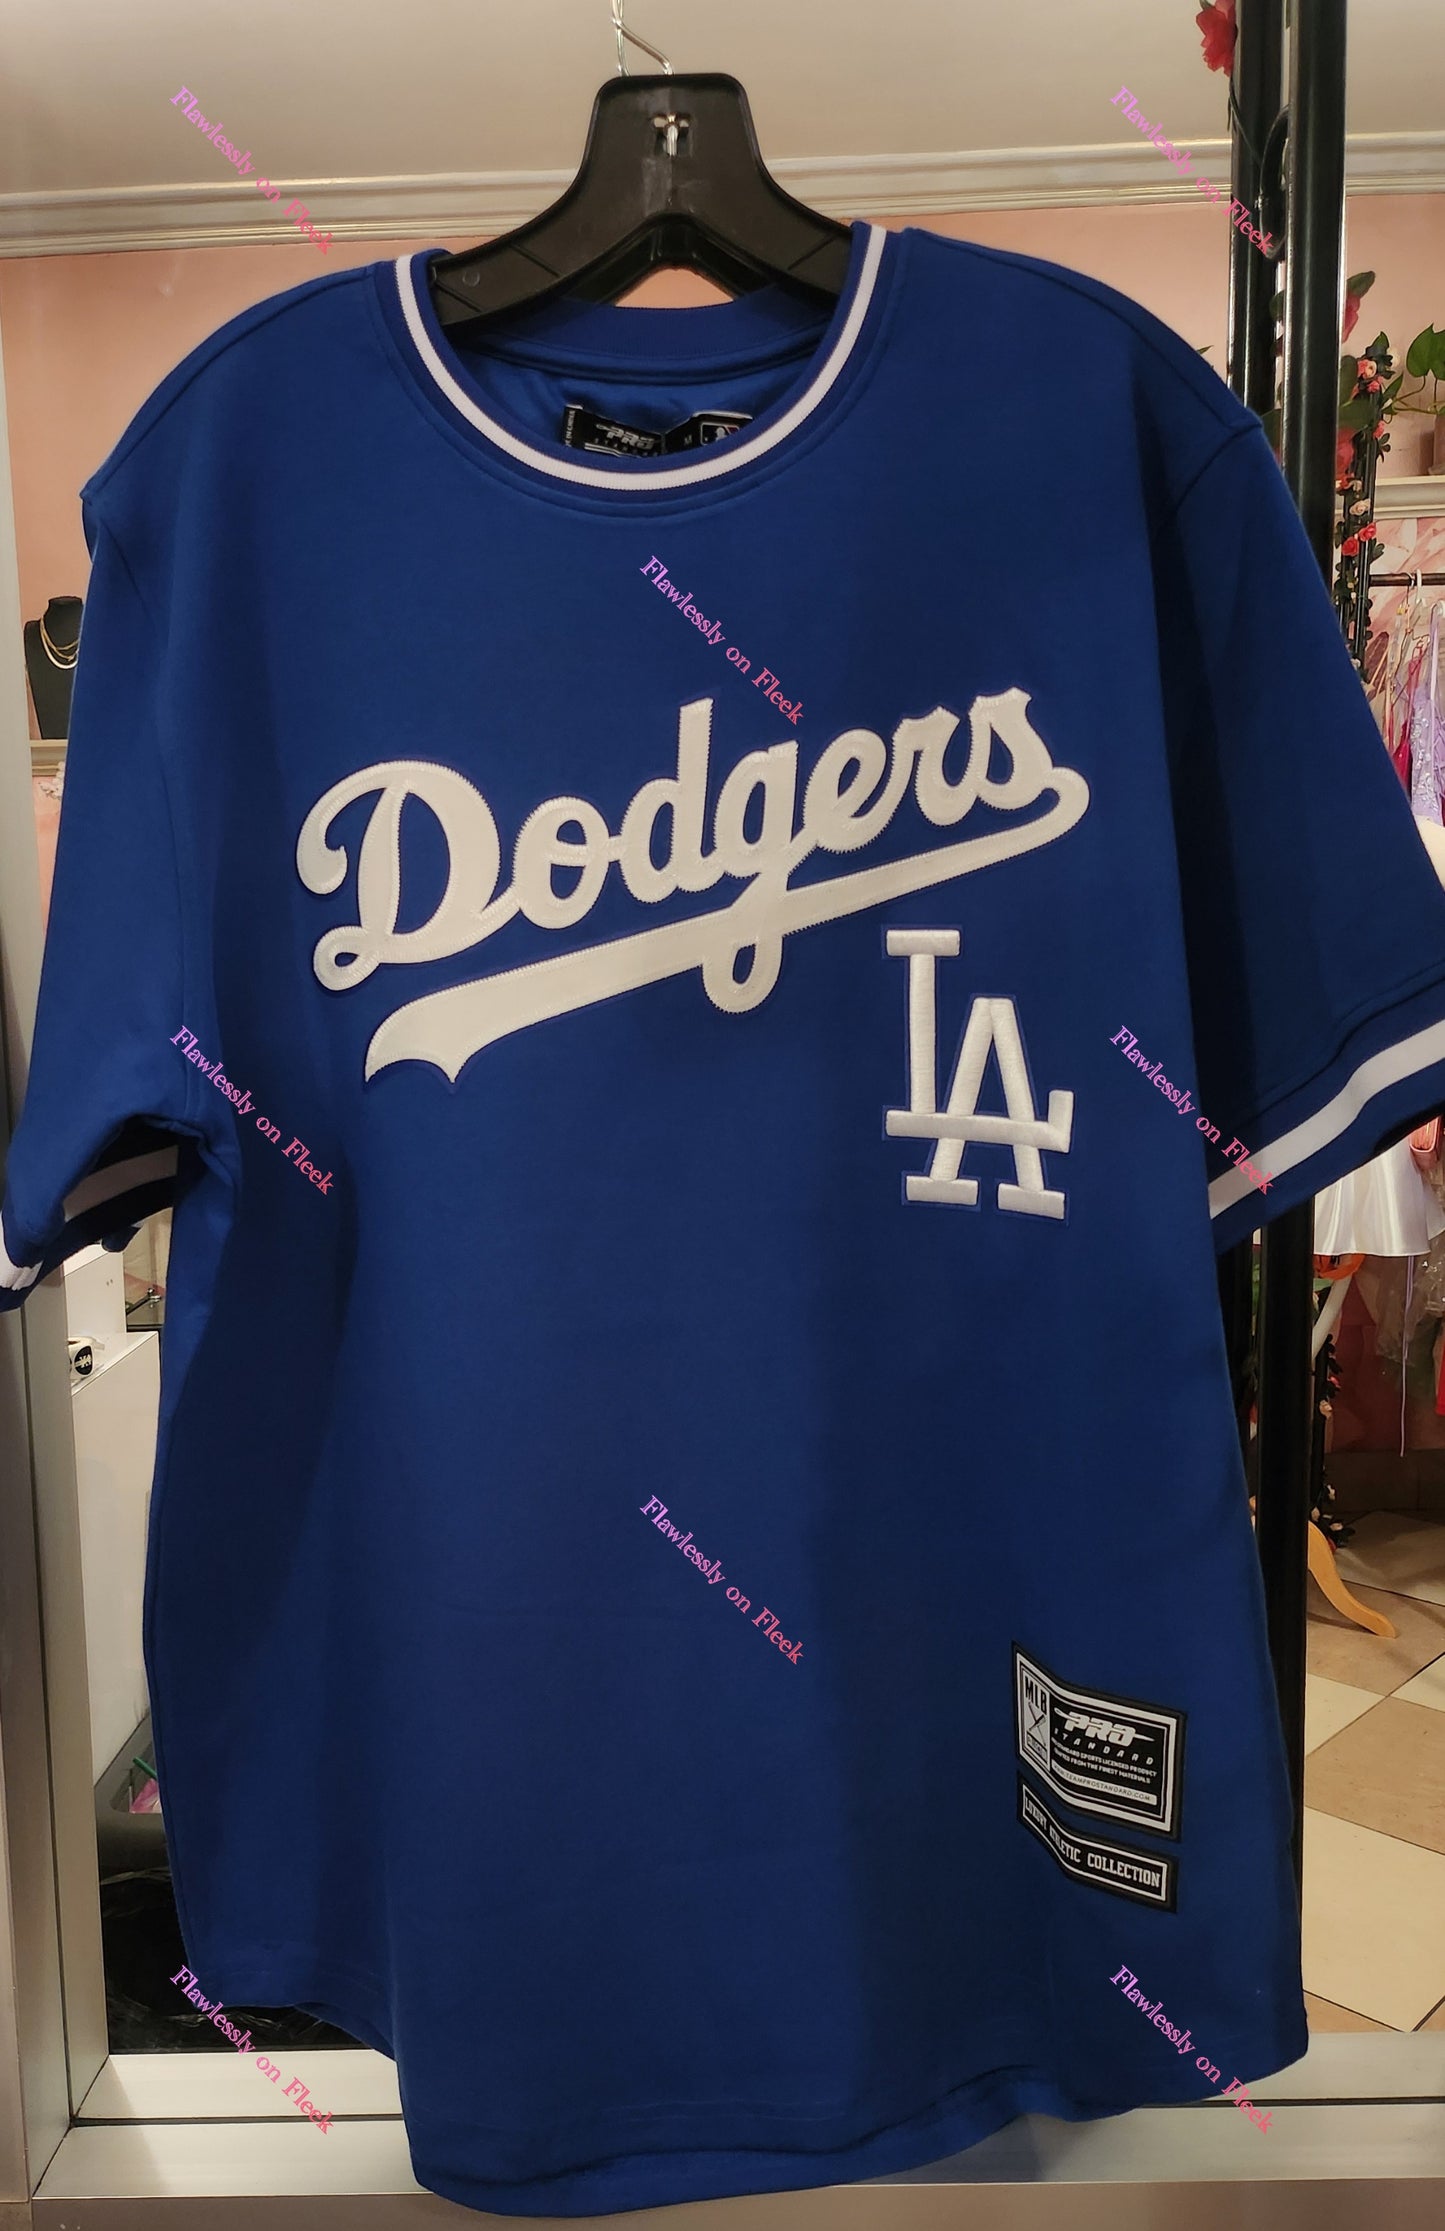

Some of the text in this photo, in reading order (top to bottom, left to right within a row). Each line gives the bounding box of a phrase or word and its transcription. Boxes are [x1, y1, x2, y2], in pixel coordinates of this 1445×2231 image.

[296, 687, 1090, 1013] Dodgers
[886, 930, 1074, 1219] LA
[1025, 1675, 1047, 1715] MLB
[1062, 1711, 1137, 1747] PRO
[1071, 1757, 1087, 1767] FROM
[1087, 1762, 1098, 1771] THE
[1099, 1765, 1118, 1776] FINEST
[1119, 1770, 1151, 1784] MATERIALS
[1102, 1759, 1129, 1770] LICENSED
[1129, 1766, 1157, 1777] PRODUCT
[1087, 1852, 1161, 1888] COLLECTION
